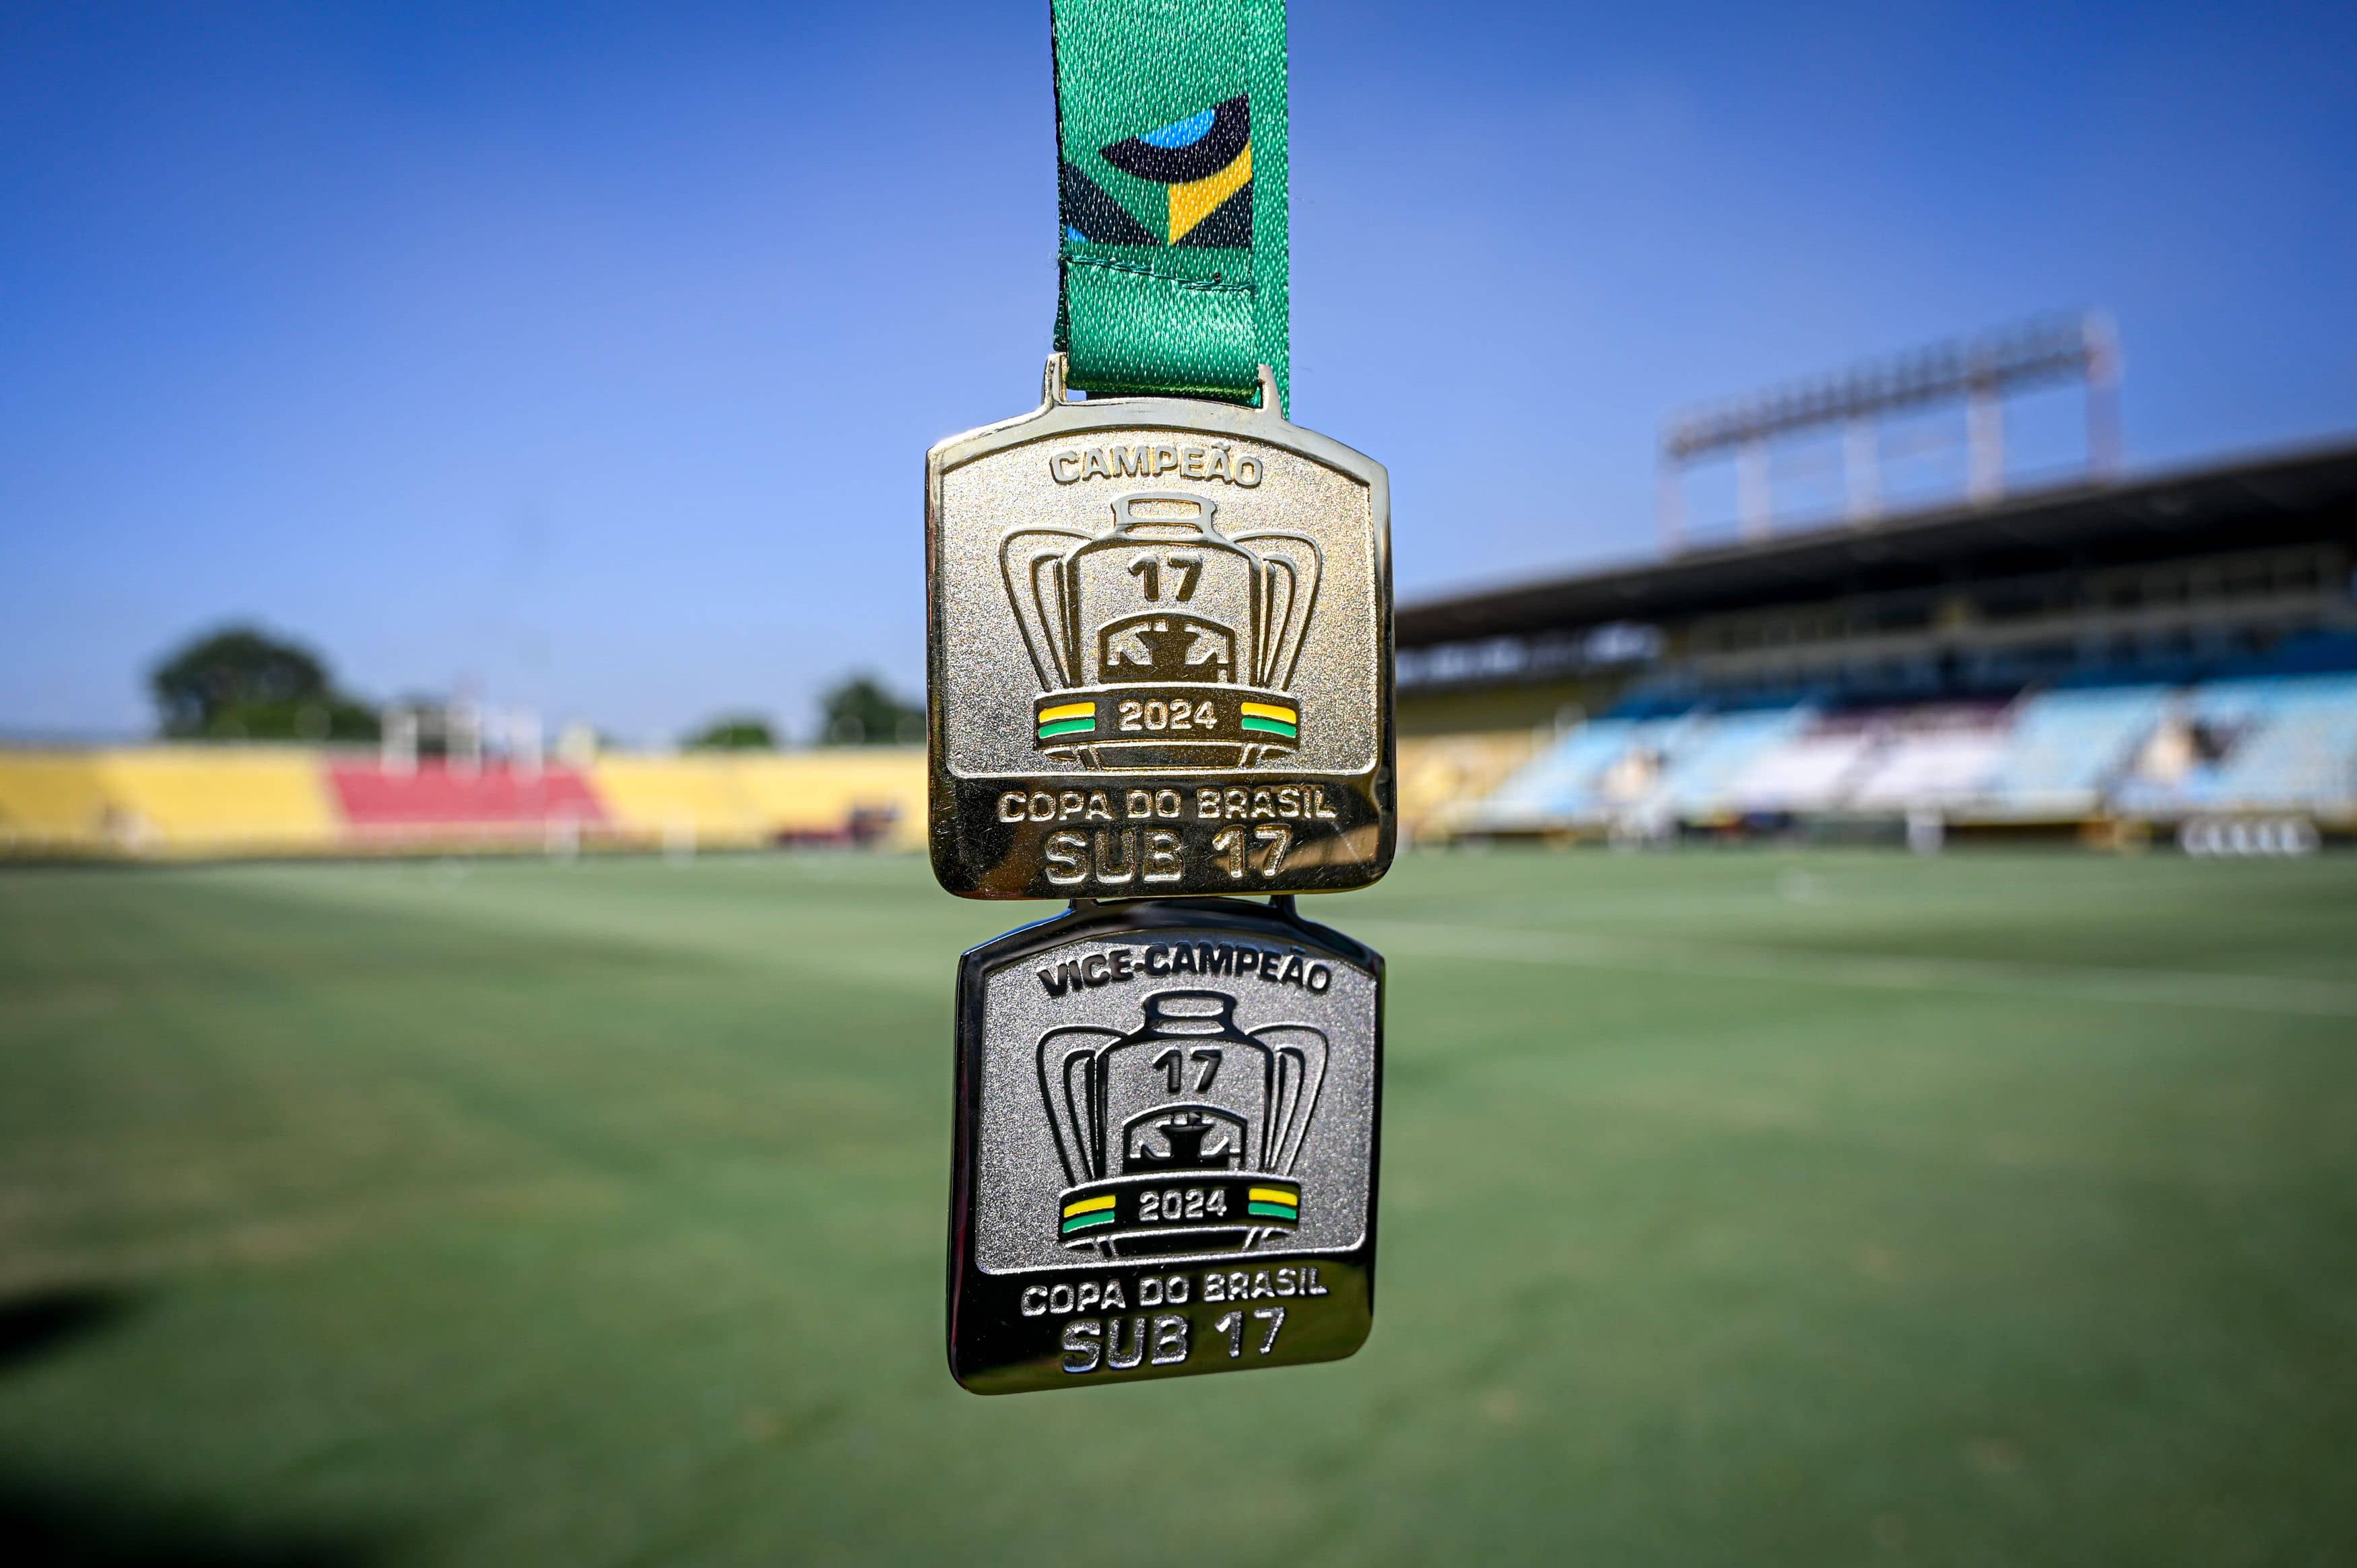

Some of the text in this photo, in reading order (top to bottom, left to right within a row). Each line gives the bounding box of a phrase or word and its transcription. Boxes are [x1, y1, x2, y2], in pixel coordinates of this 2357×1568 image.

[1050, 441, 1263, 488] CAMPEÃO
[1128, 553, 1203, 601] 17
[1119, 700, 1217, 730] 2024
[997, 786, 1336, 823] COPA DO BRASIL
[1044, 824, 1292, 884] SUB 17
[1036, 942, 1331, 997] VICE-CAMPEÃO
[1152, 1049, 1222, 1093] 17
[1139, 1189, 1227, 1222] 2024
[1020, 1268, 1329, 1316] COPA DO BRASIL
[1060, 1307, 1286, 1373] SUB 17
